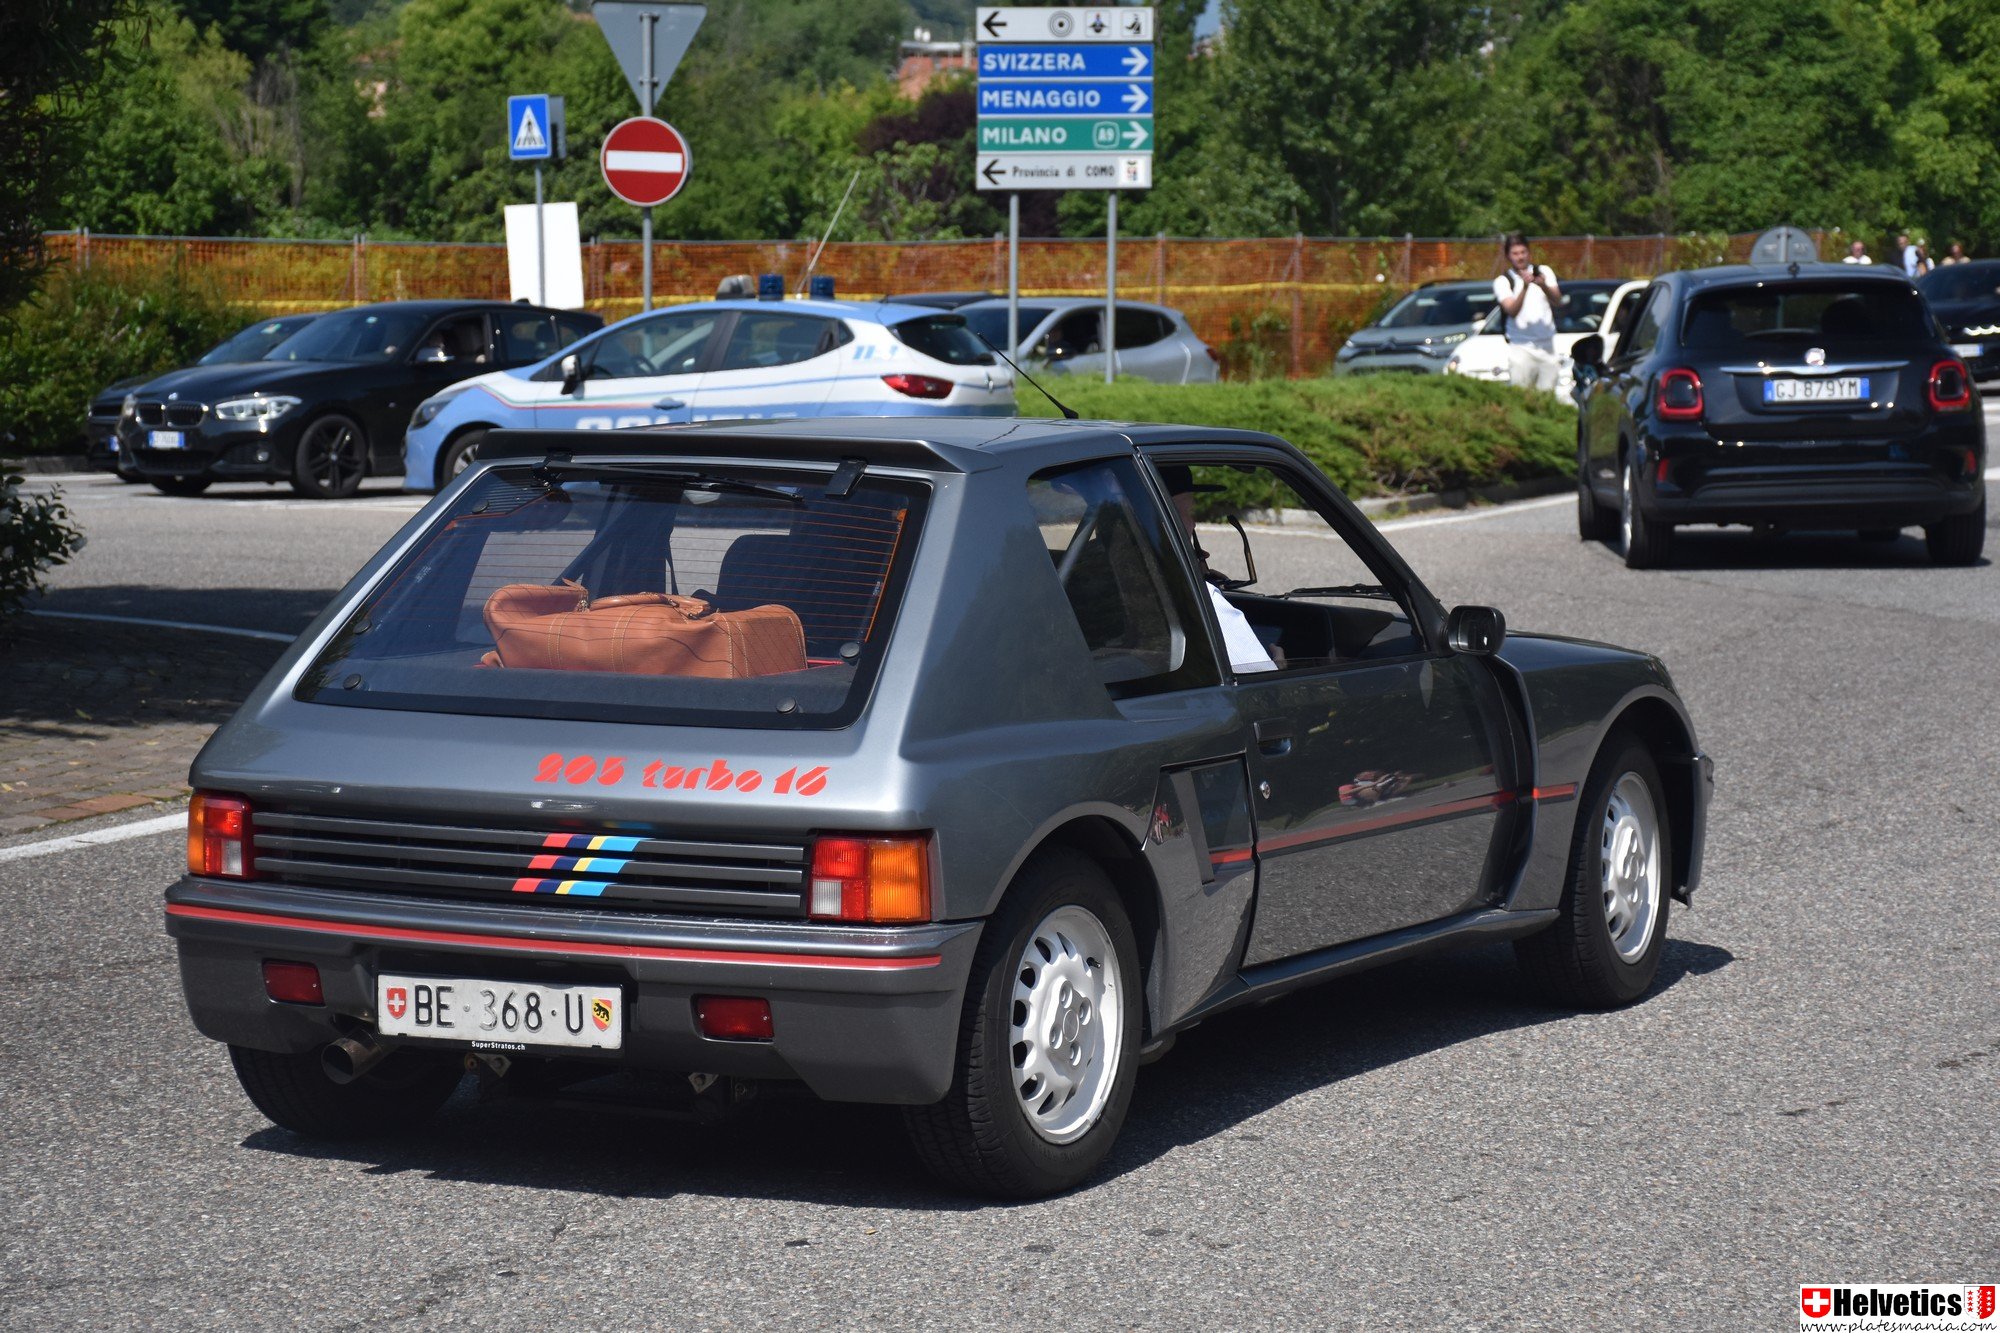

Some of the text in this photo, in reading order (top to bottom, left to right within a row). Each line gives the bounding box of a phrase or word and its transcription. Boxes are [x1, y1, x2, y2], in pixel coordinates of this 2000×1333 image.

[983, 53, 1086, 71] SVIZZERA
[981, 90, 1101, 108] MENAGGIO
[982, 126, 1068, 145] MILANO
[1012, 165, 1115, 177] Provincia di COMO
[532, 752, 831, 797] 205 turbo 16
[471, 1041, 526, 1051] SuperStratos.ch
